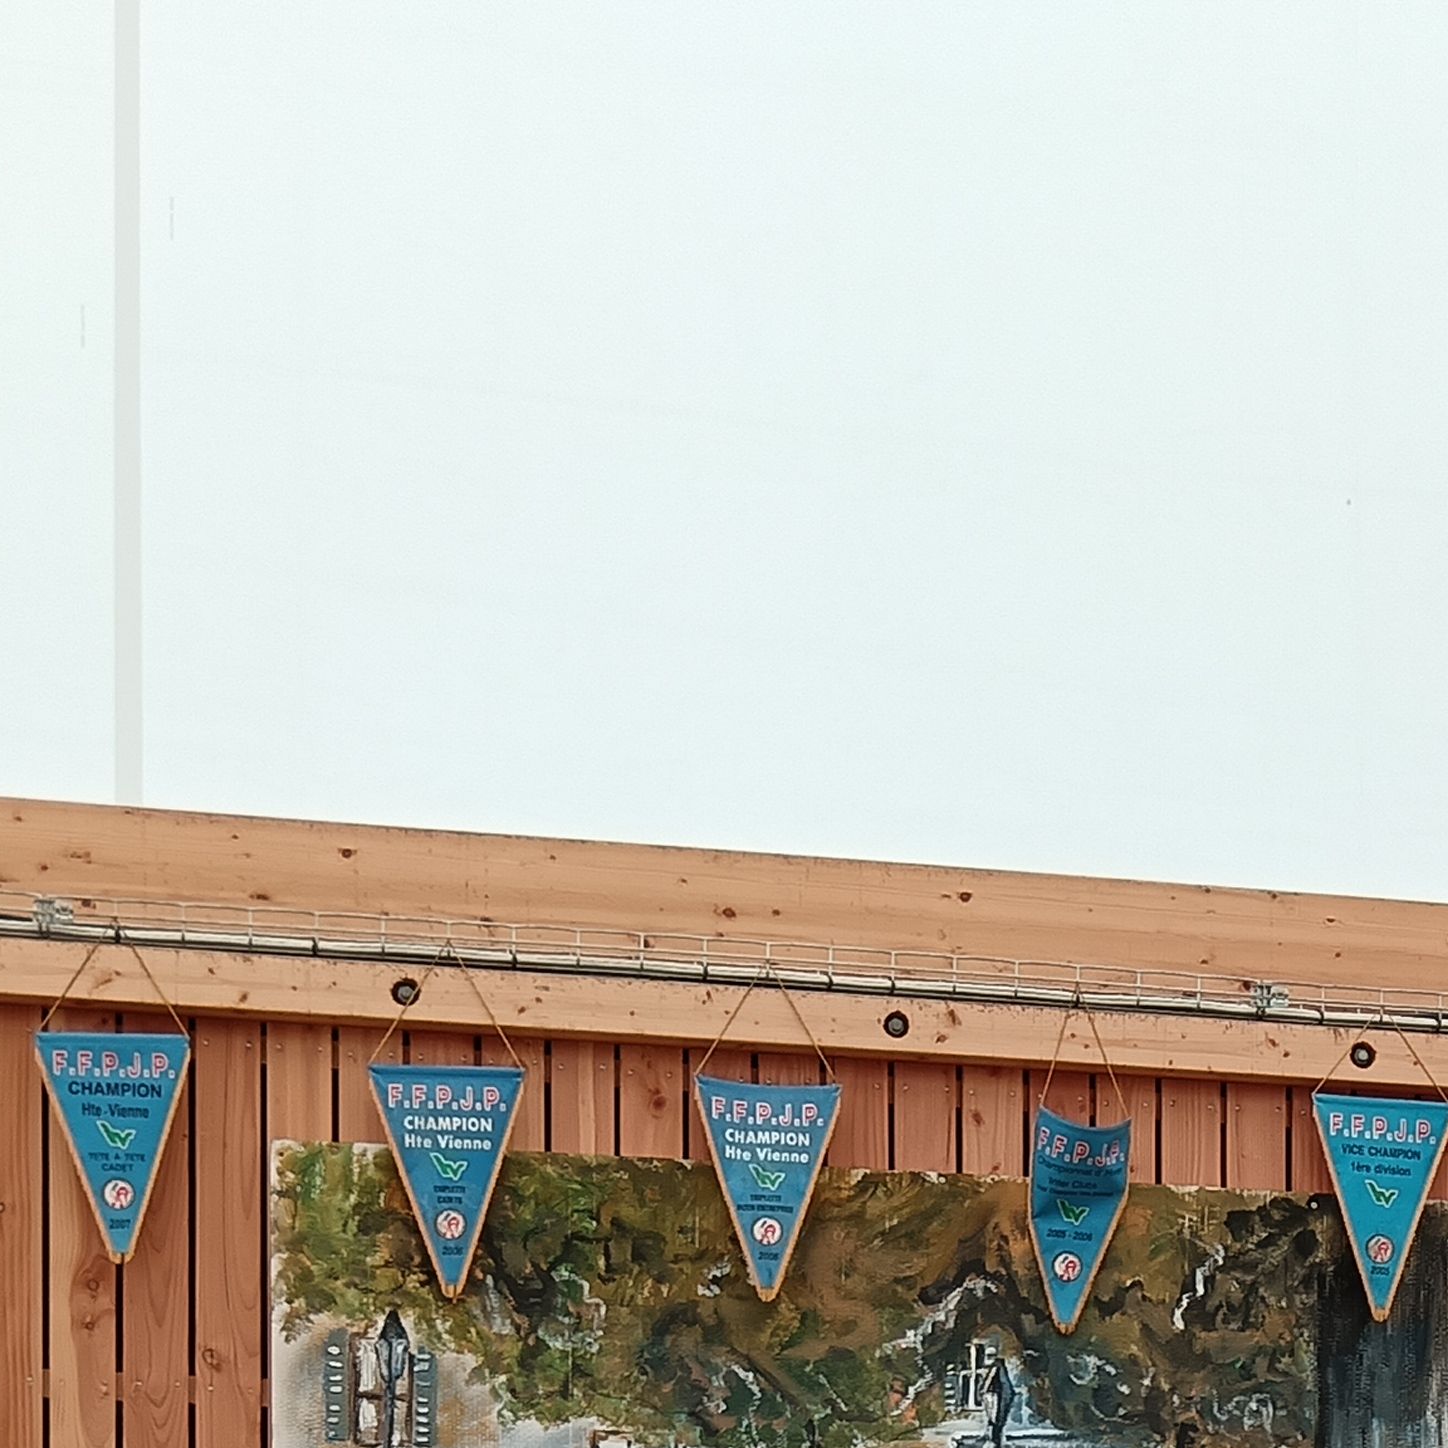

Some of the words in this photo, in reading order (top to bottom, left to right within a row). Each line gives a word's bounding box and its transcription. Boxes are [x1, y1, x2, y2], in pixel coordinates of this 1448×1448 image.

[52, 1050, 175, 1079] F.F.P.J.P.
[67, 1081, 162, 1098] CHAMPION
[387, 1083, 507, 1112] F.F.P.J.P.
[711, 1096, 824, 1128] F.F.P.J.P.
[403, 1115, 493, 1132] CHAMPION
[1330, 1112, 1436, 1145] F.F.P.J.P.
[404, 1134, 433, 1148] Hte
[437, 1135, 492, 1150] Vienne
[724, 1128, 810, 1147] CHAMPION
[1037, 1127, 1125, 1167] F.F.P.J.P.
[724, 1146, 752, 1161] Hte
[755, 1147, 809, 1164] Vienne
[1341, 1144, 1365, 1156] VICE
[1368, 1146, 1421, 1160] CHAMPION
